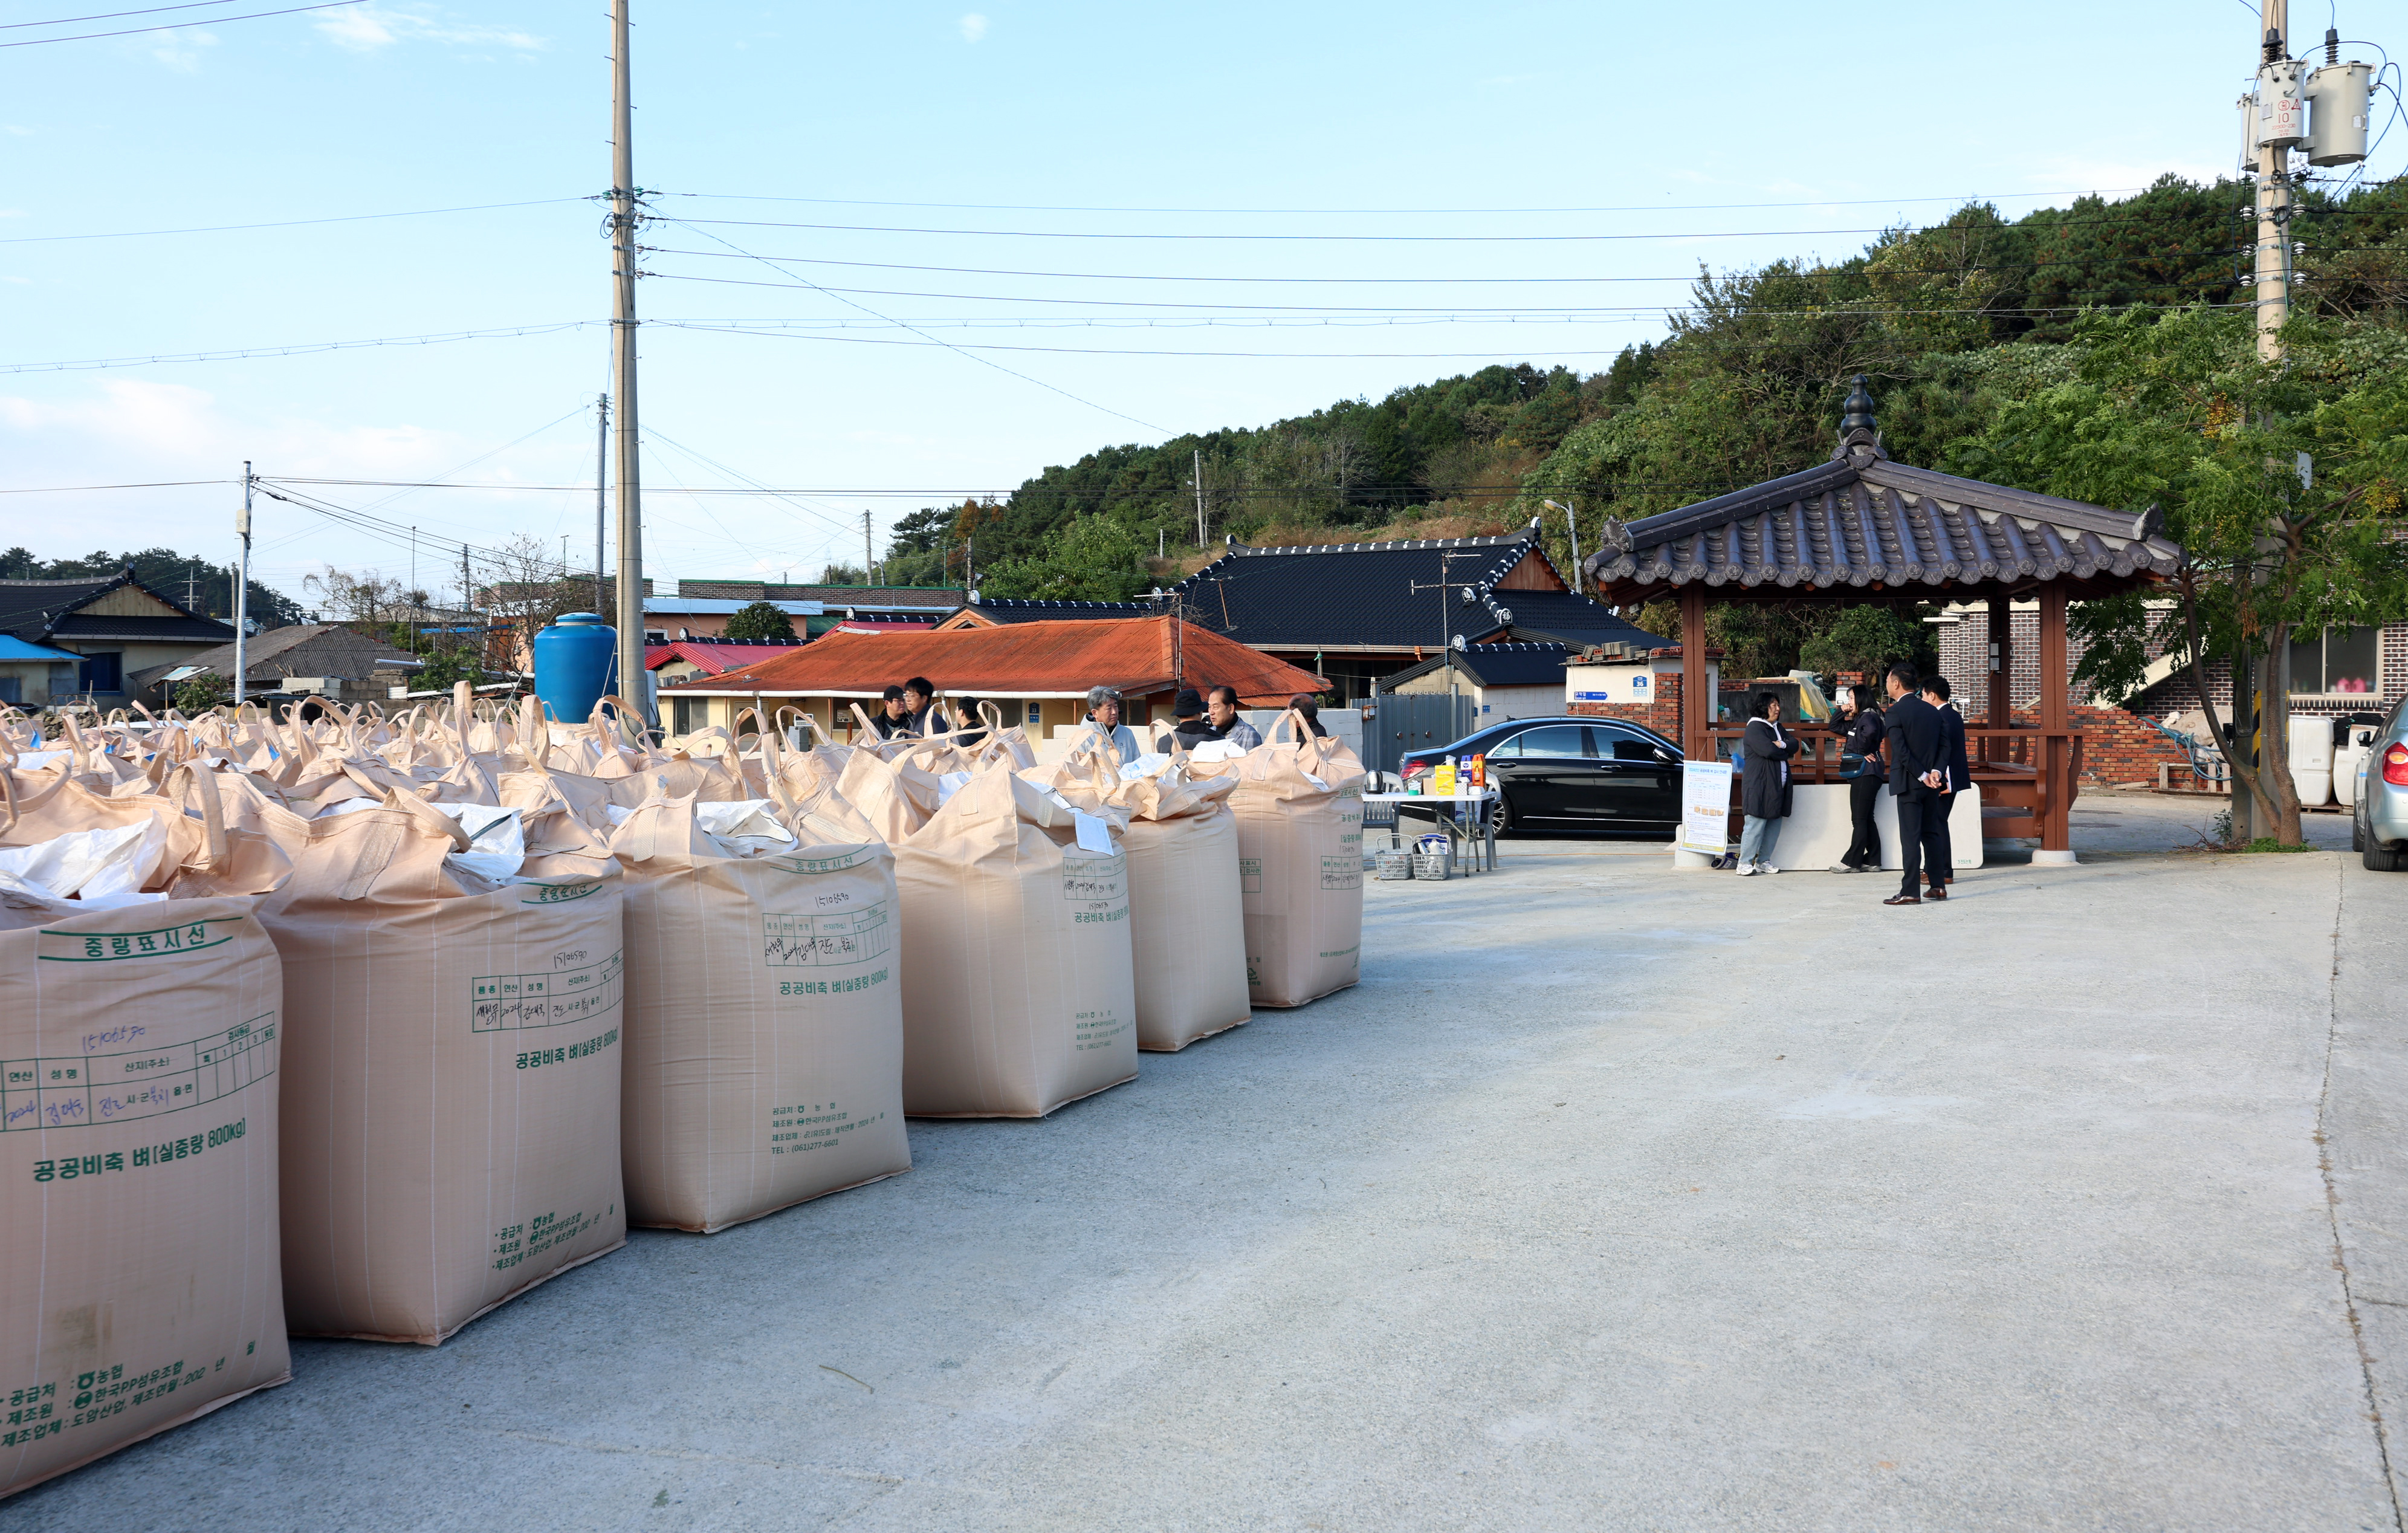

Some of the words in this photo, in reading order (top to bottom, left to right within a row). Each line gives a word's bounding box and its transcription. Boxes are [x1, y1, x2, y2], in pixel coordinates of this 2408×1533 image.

[2278, 112, 2290, 123] 10
[1503, 611, 1511, 620] 福
[1453, 637, 1461, 647] 福
[795, 855, 854, 872] 중량표시선
[815, 893, 849, 909] 15106590
[1075, 912, 1104, 923] 공공비축
[85, 924, 206, 957] 중량표시선
[554, 950, 587, 969] 15106590
[503, 984, 518, 993] 연산
[527, 982, 543, 991] 성명
[780, 981, 827, 995] 공공비축
[500, 1002, 522, 1018] 2024
[238, 1042, 243, 1051] 2
[253, 1035, 257, 1043] 3
[516, 1047, 565, 1069] 공공비축
[8, 1071, 33, 1083] 연산
[50, 1069, 77, 1080] 성명
[772, 1132, 798, 1142] 제조업체
[771, 1146, 785, 1155] TEL
[791, 1138, 839, 1153] (061)277-6601
[32, 1151, 124, 1182] 공공비축
[500, 1223, 523, 1240] 공급처
[499, 1238, 521, 1255] 제조원
[215, 1356, 225, 1372] 년
[9, 1381, 56, 1407] 공급처
[96, 1363, 123, 1384] 농협
[7, 1402, 53, 1426] 제조원
